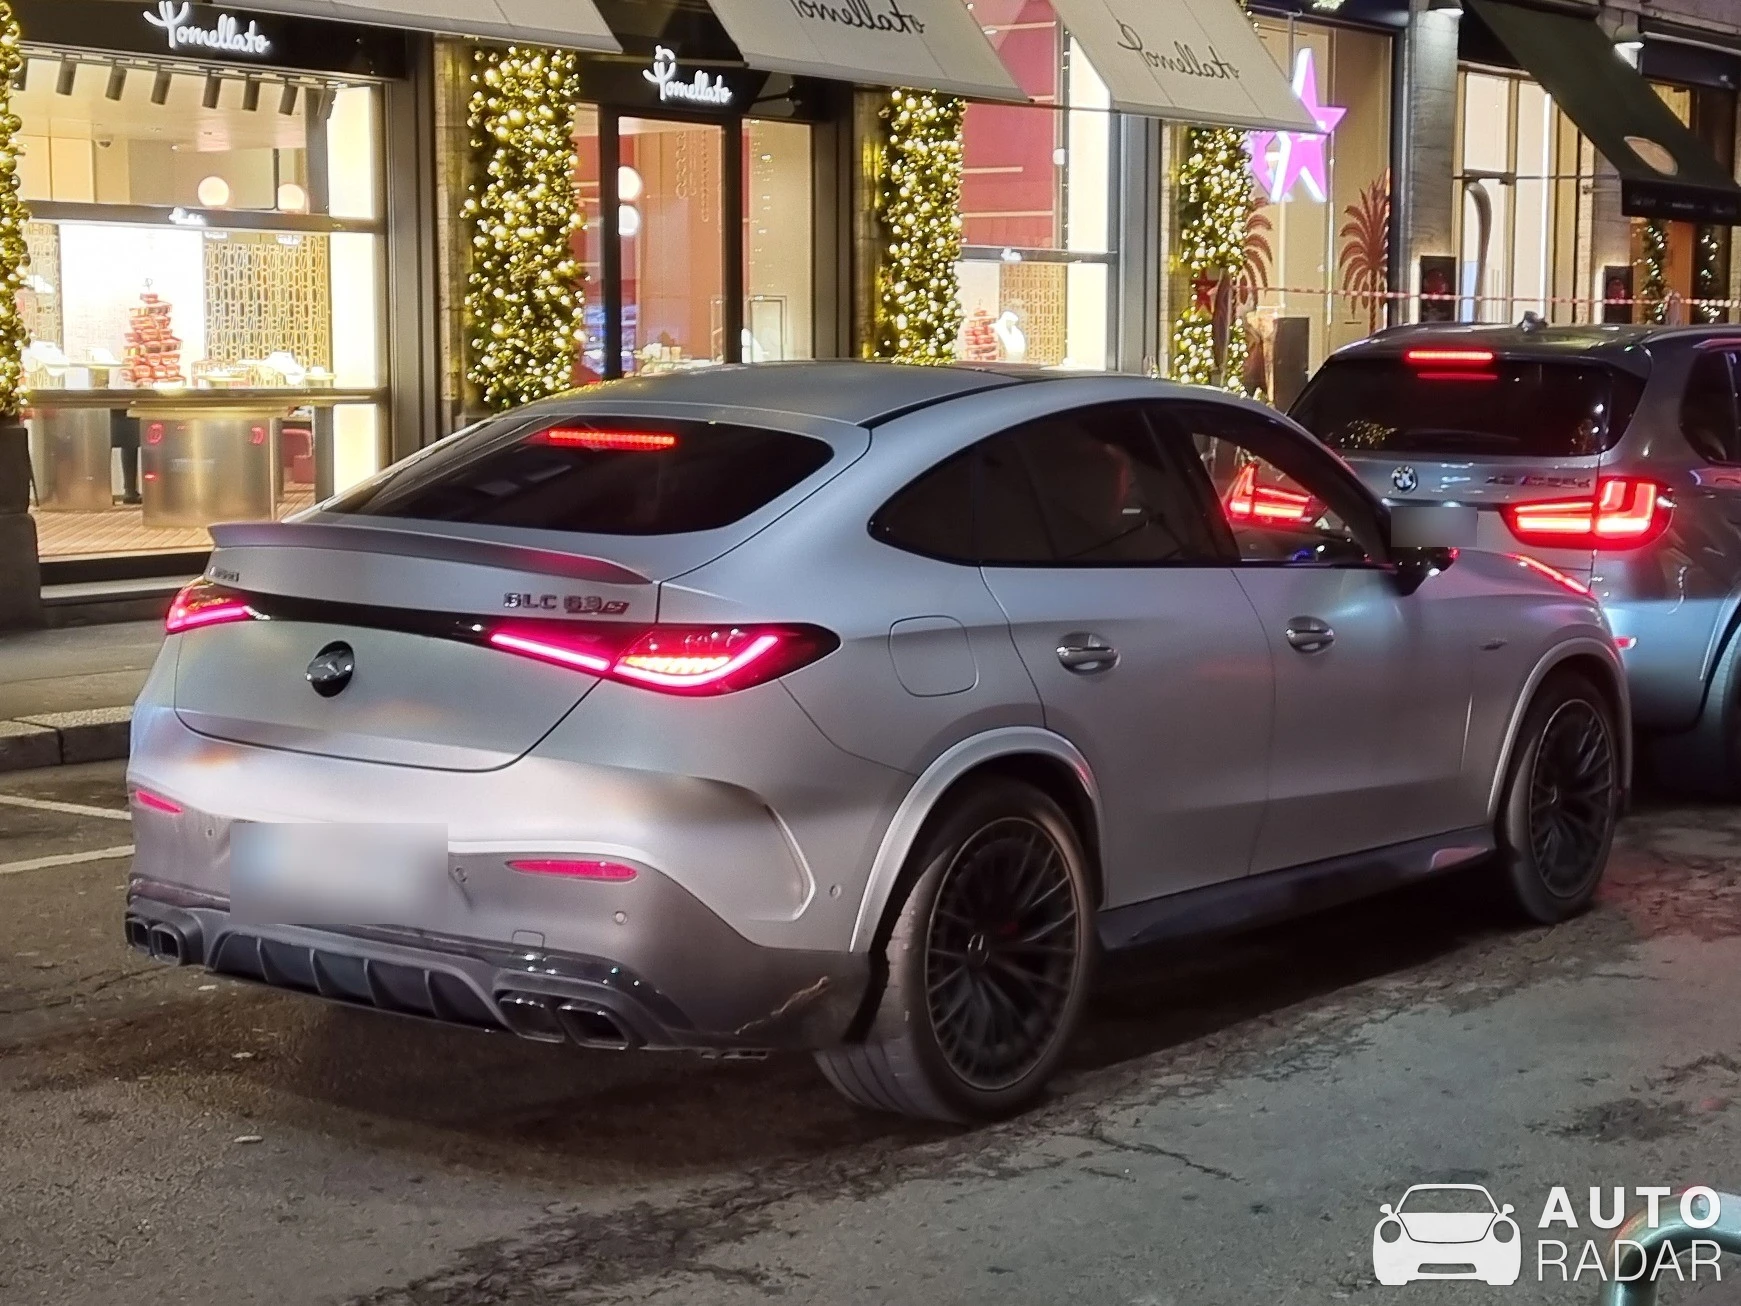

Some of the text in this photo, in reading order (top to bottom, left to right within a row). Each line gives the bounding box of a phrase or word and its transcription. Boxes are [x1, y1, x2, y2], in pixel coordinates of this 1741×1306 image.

[788, 0, 925, 33] omellato
[642, 44, 733, 103] Pomellato
[1115, 19, 1240, 79] Pomellato
